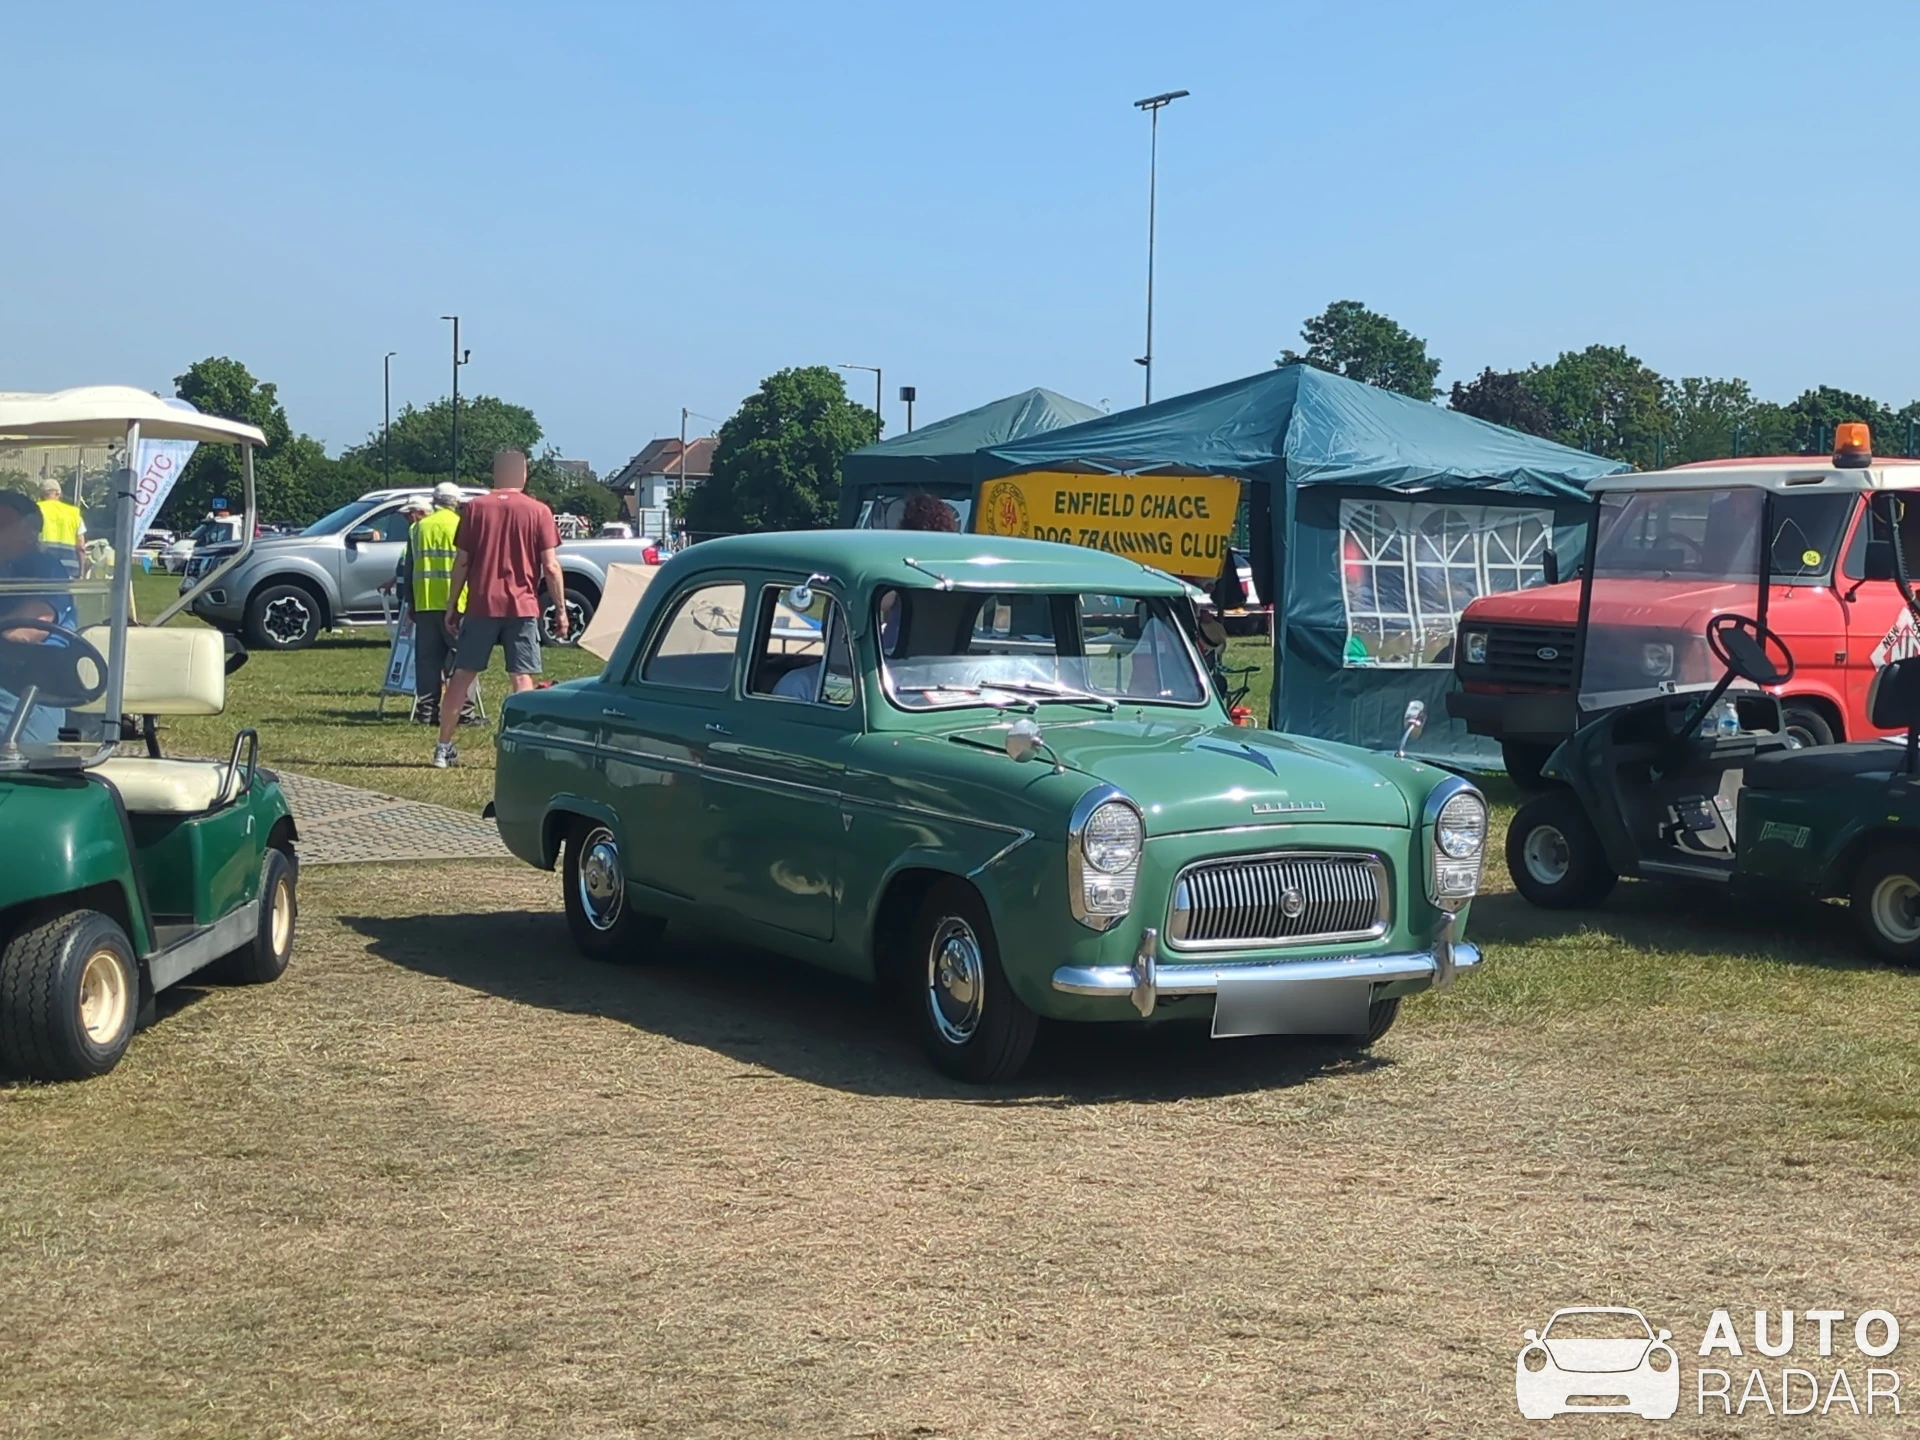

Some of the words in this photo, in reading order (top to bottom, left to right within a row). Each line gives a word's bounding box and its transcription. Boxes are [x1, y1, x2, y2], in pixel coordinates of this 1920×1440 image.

[1054, 490, 1135, 517] ENFIELD
[1140, 494, 1210, 519] CHACE
[1034, 525, 1072, 544] DOG
[1079, 529, 1173, 555] TRAINING
